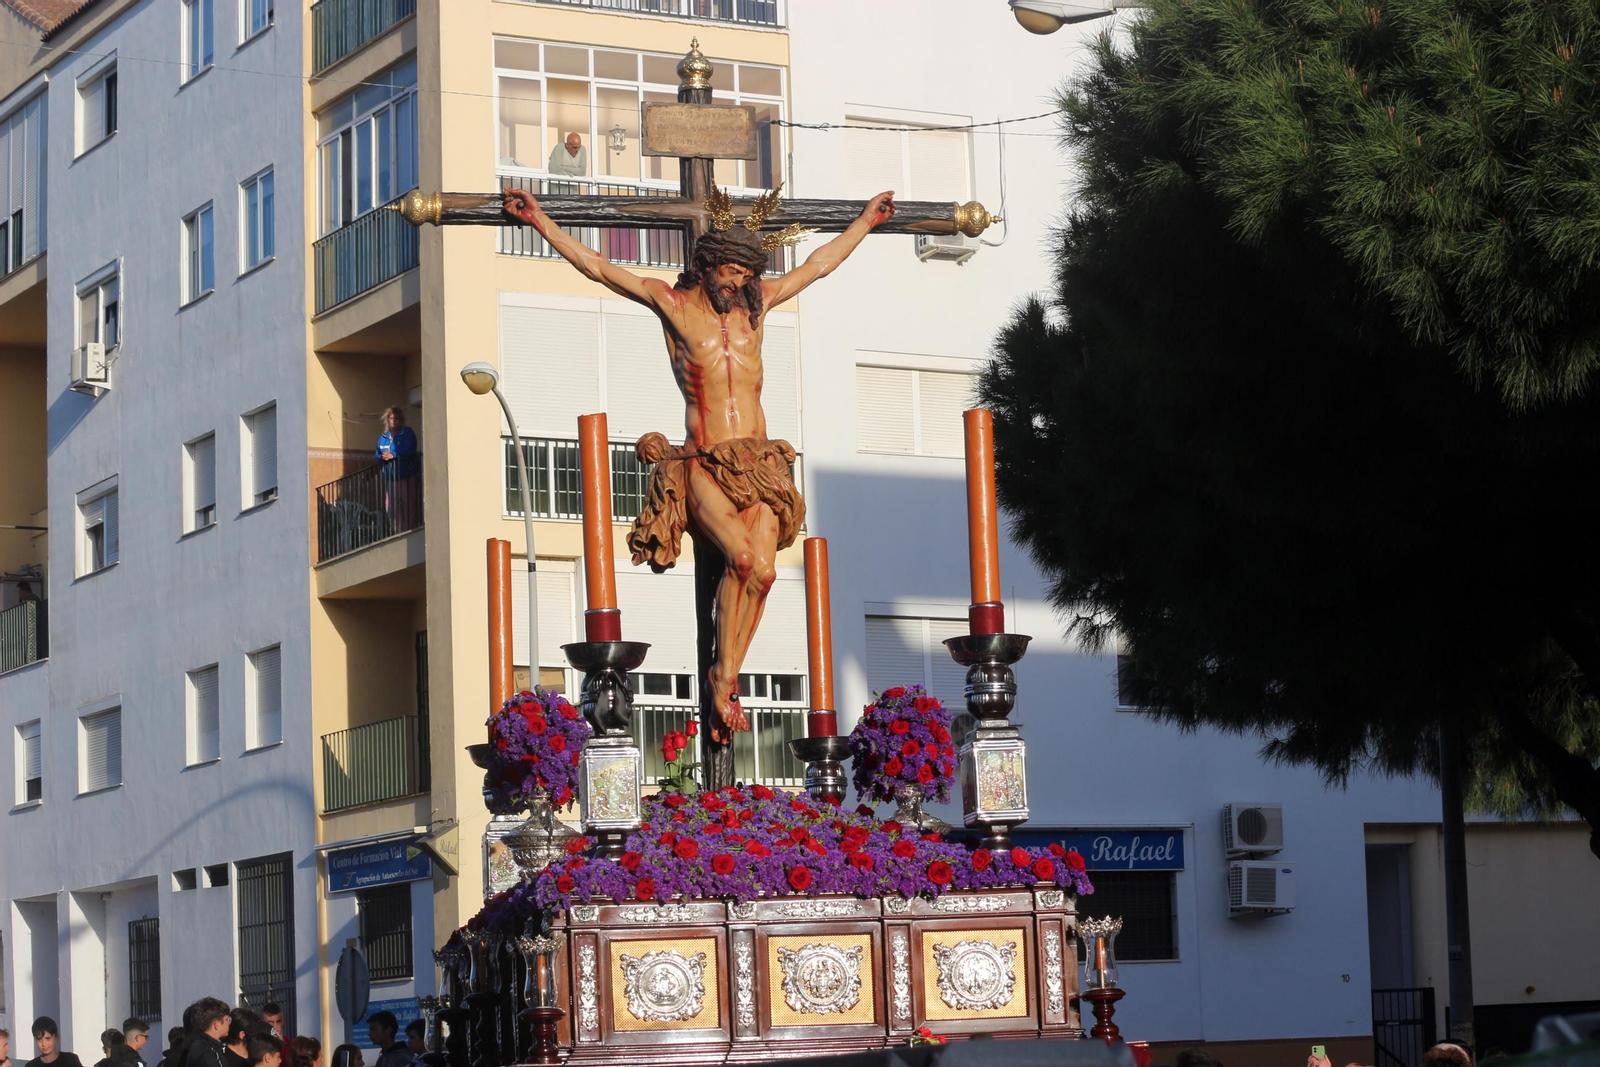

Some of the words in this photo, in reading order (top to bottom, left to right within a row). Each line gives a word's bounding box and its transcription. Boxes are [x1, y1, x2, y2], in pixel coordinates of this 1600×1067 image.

[333, 857, 352, 869] Centro
[352, 854, 359, 865] de
[360, 849, 389, 865] Formación
[391, 846, 402, 859] Vial
[440, 839, 457, 858] Rafael
[1091, 836, 1175, 868] Rafael
[1341, 974, 1350, 983] 10
